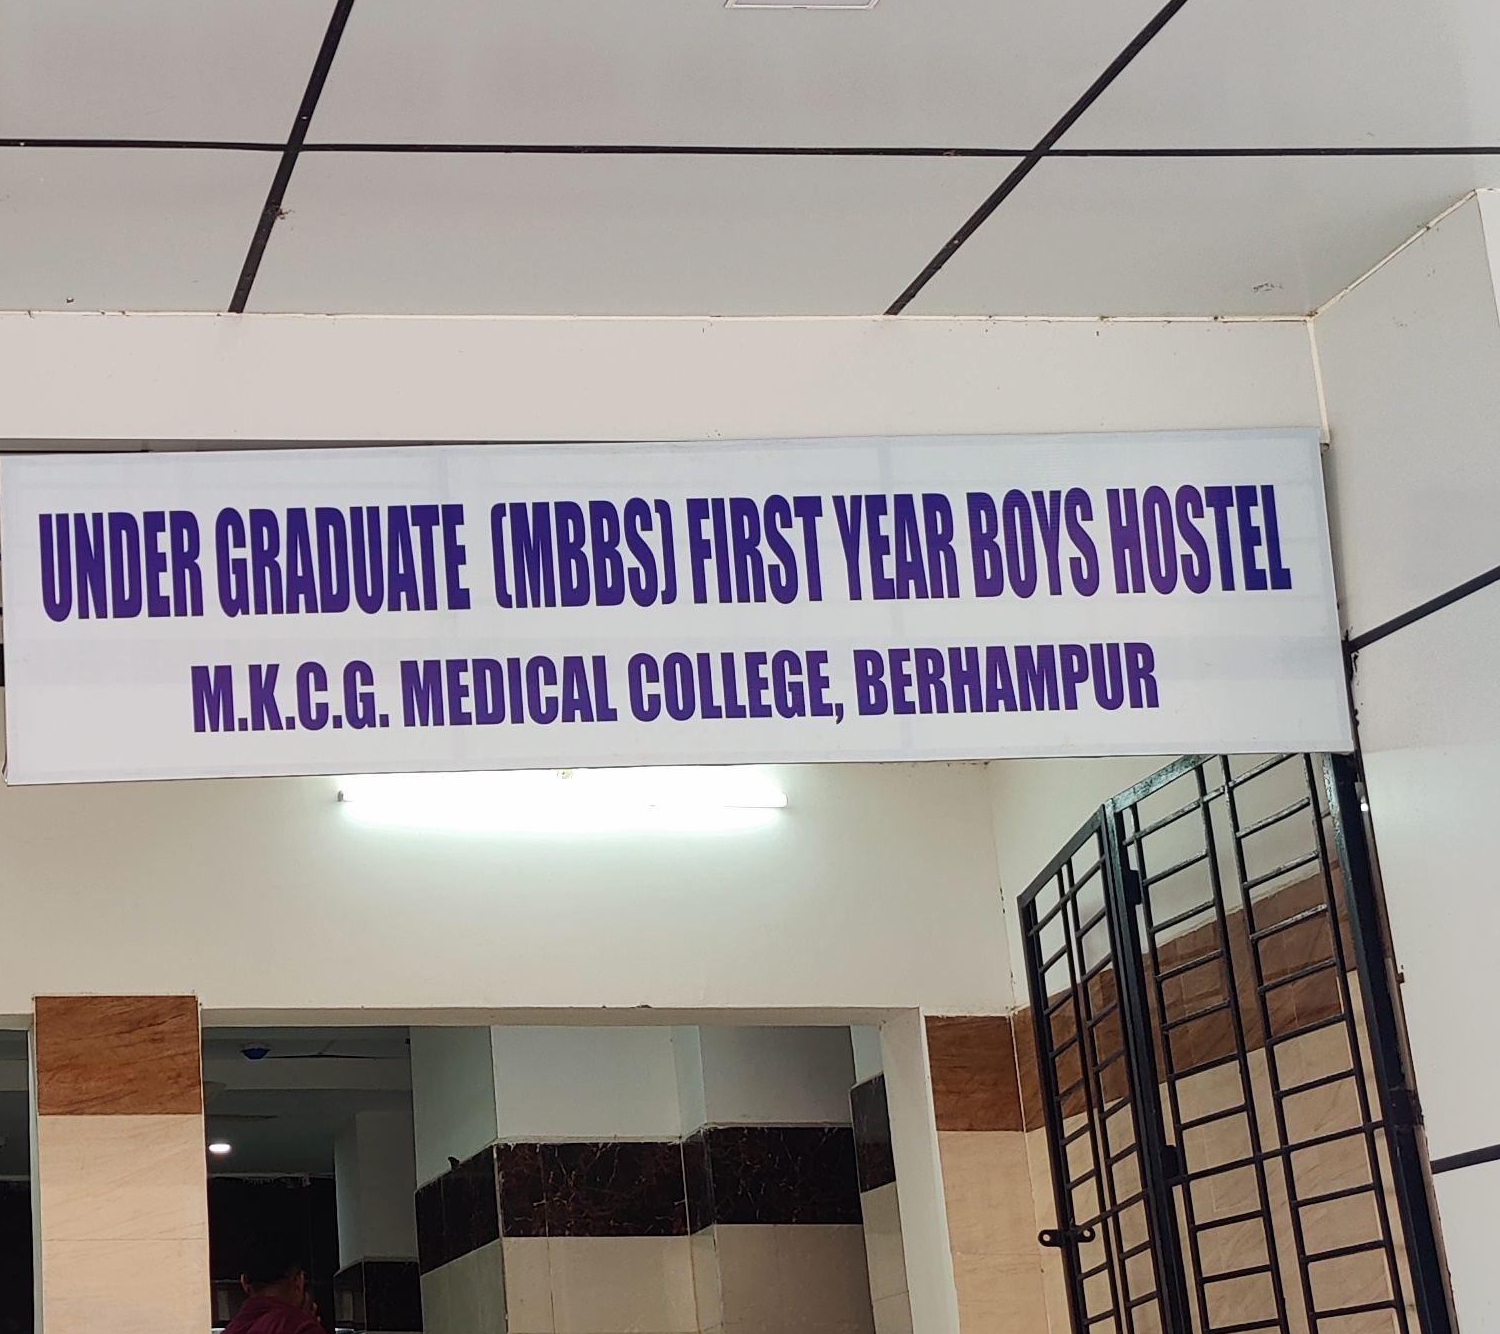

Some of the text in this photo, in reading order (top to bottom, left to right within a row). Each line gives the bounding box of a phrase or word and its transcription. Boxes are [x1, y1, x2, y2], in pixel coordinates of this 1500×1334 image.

[38, 510, 204, 623] UNDER
[215, 503, 472, 618] GRADUATE
[685, 494, 825, 606] FIRST
[831, 492, 962, 602] YEAR
[965, 487, 1101, 598] BOYS
[1105, 484, 1293, 596] HOSTEL
[190, 642, 1160, 733] M.K.C.G. MEDICAL COLLEGE, BERHAMPUR
